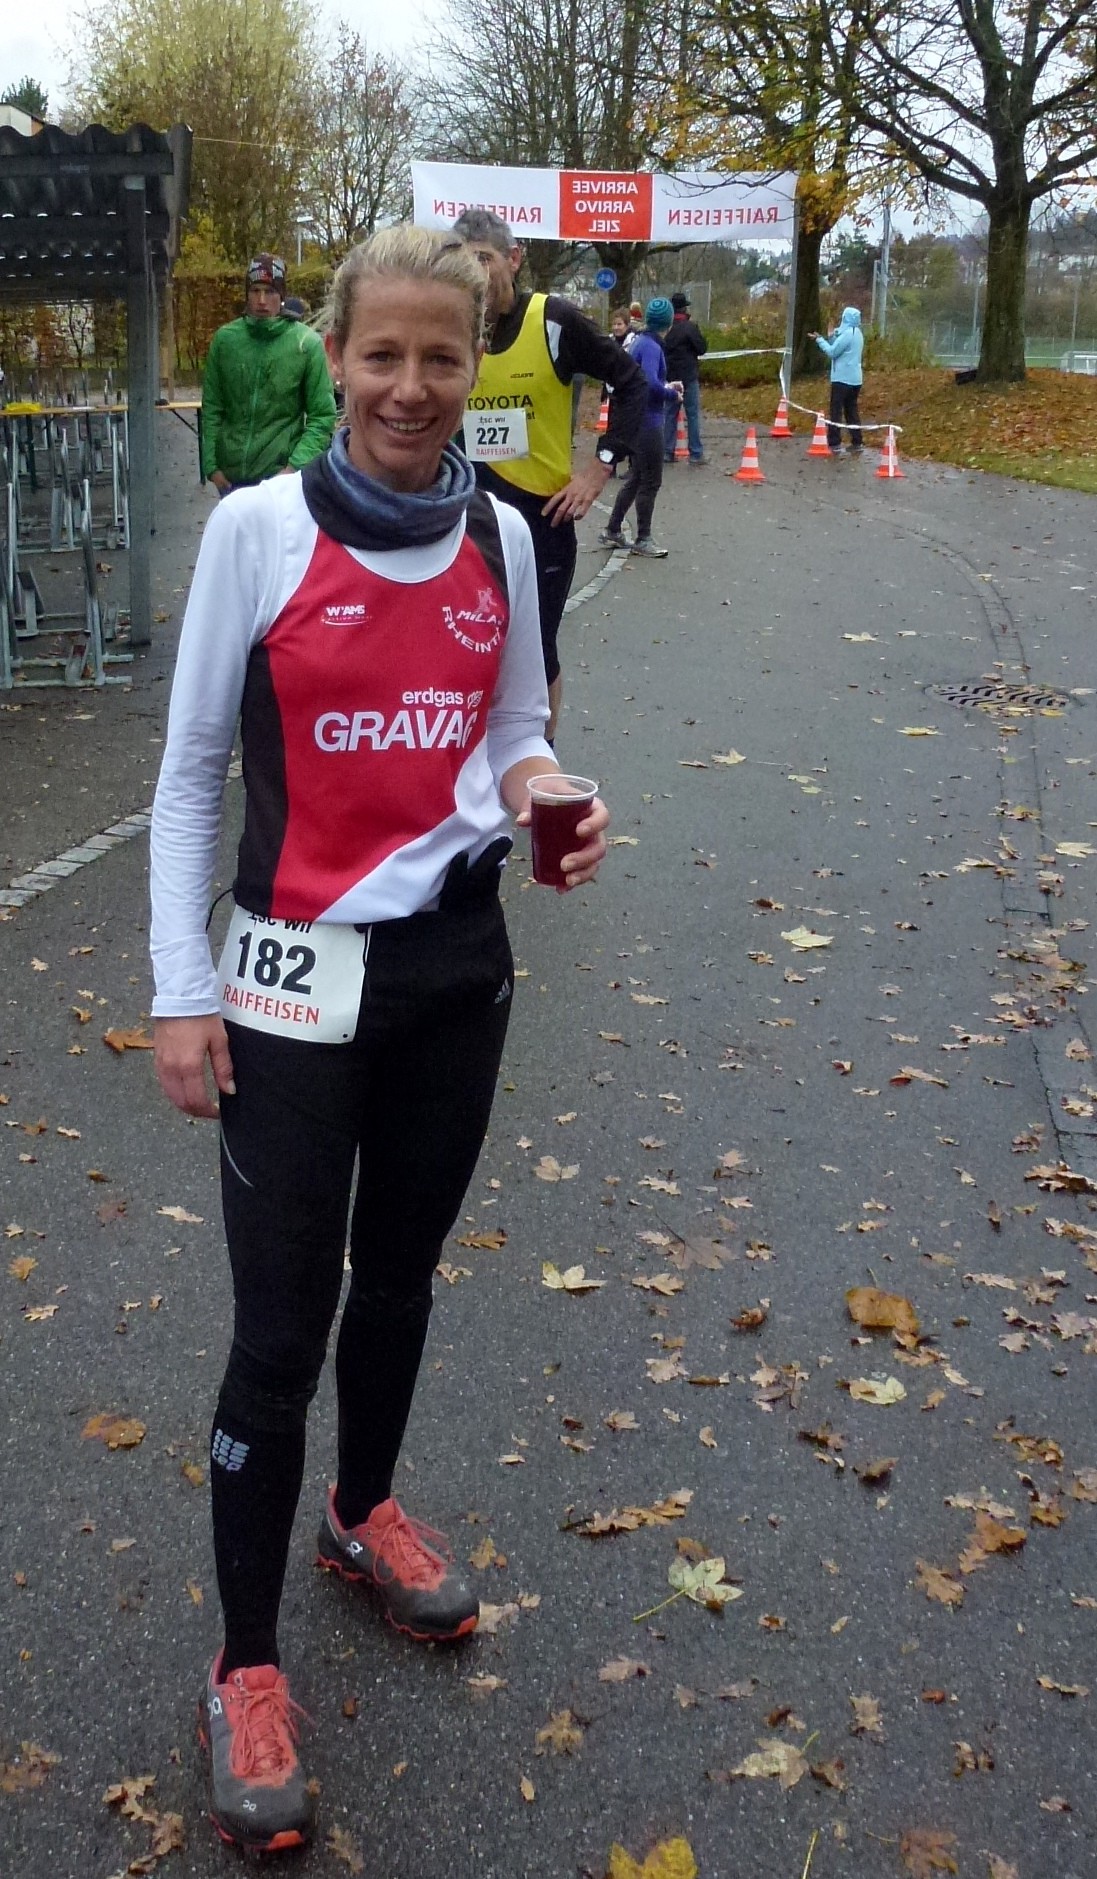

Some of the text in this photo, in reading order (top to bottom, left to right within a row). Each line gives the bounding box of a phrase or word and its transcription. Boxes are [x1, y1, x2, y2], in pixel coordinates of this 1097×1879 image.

[467, 395, 533, 410] TOYOTA
[476, 427, 510, 445] 227
[476, 448, 516, 456] RAIFFEISEN
[402, 687, 464, 707] erdgas
[237, 931, 316, 995] 182
[223, 984, 320, 1025] RAIFFEISEN
